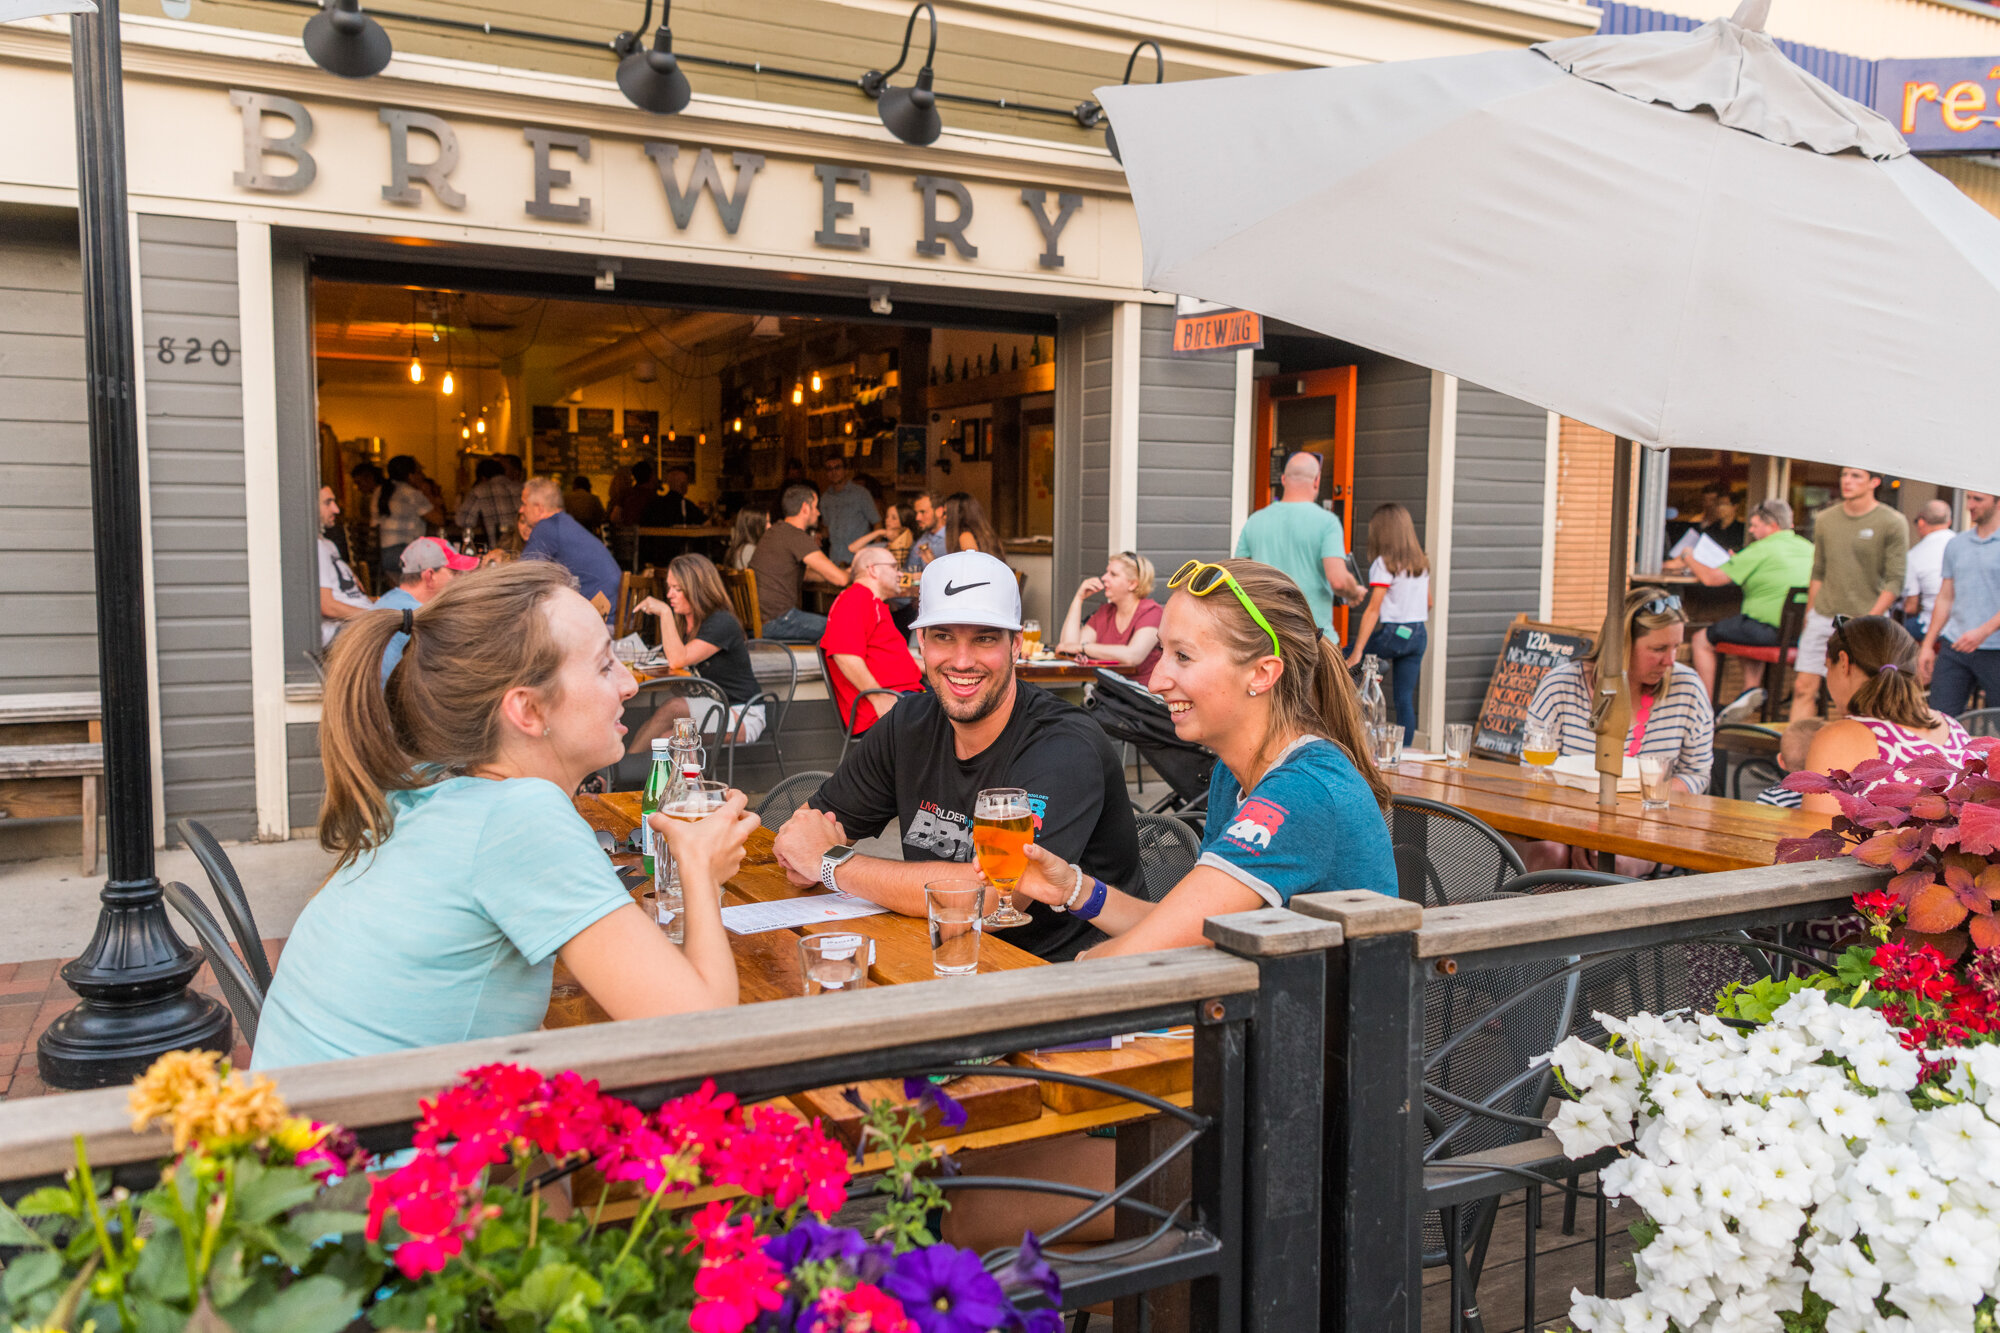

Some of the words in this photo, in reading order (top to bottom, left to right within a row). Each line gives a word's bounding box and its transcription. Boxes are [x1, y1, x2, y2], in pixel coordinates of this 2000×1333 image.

[1901, 81, 2000, 135] re
[229, 88, 1083, 268] BREWERY
[1183, 314, 1251, 349] BREWING
[158, 336, 231, 367] 820
[1484, 715, 1517, 735] SULLY
